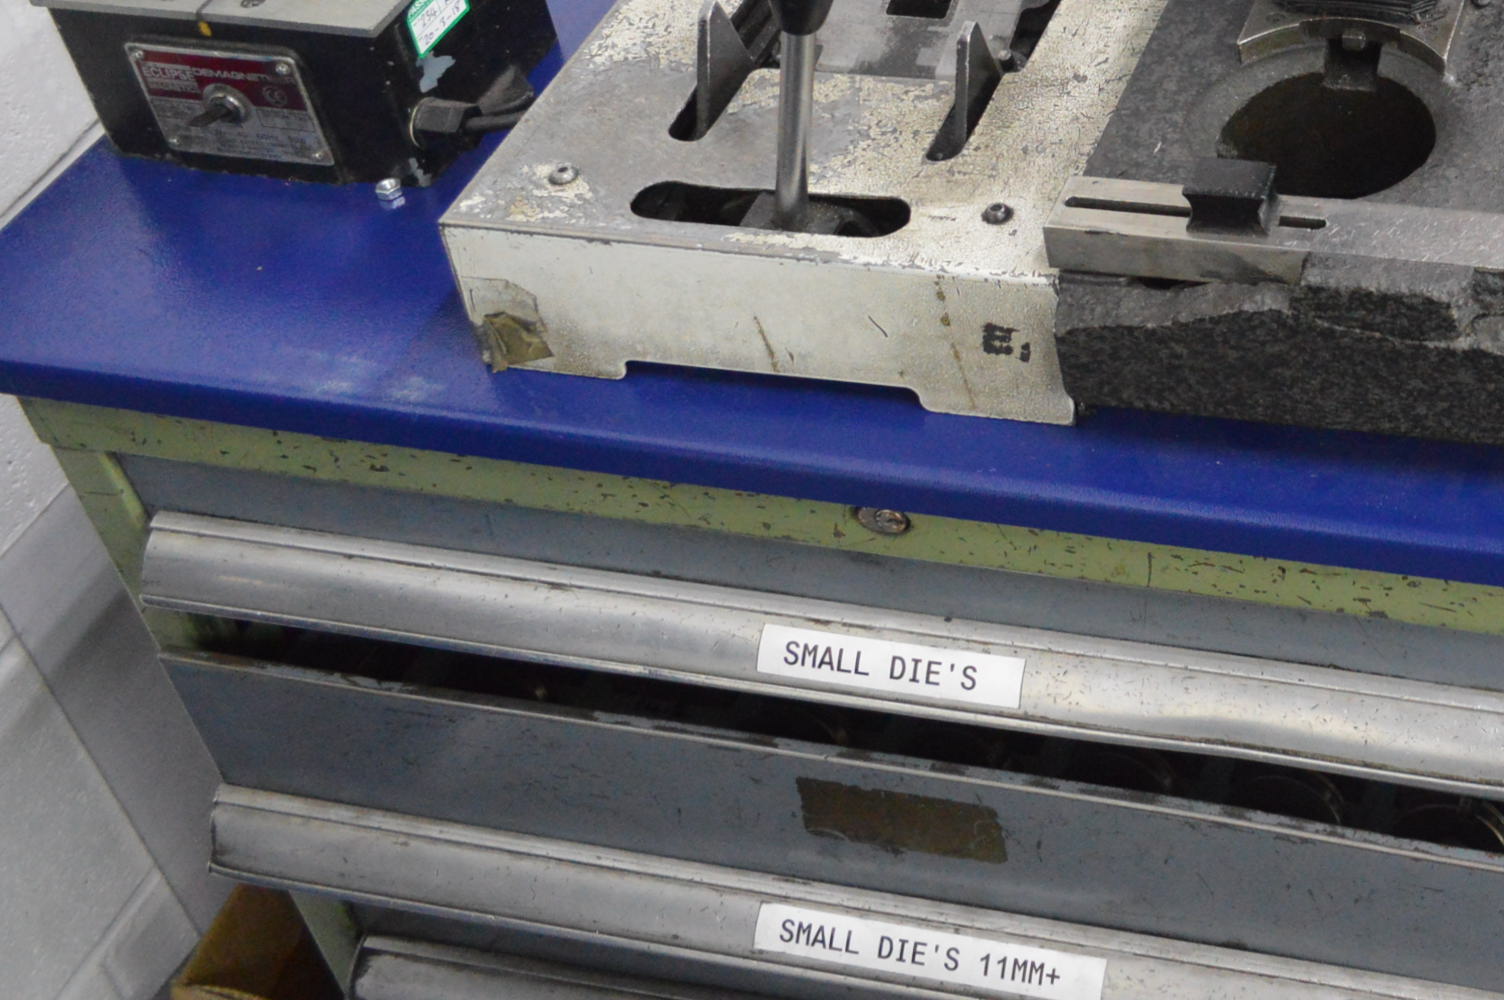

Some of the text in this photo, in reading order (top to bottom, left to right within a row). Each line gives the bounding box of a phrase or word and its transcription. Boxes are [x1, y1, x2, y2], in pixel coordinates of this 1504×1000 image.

[143, 65, 194, 82] ECLIPSE
[783, 640, 978, 692] SMALL DIE'S
[779, 918, 1061, 987] SMALL DIE'S 11MM+
